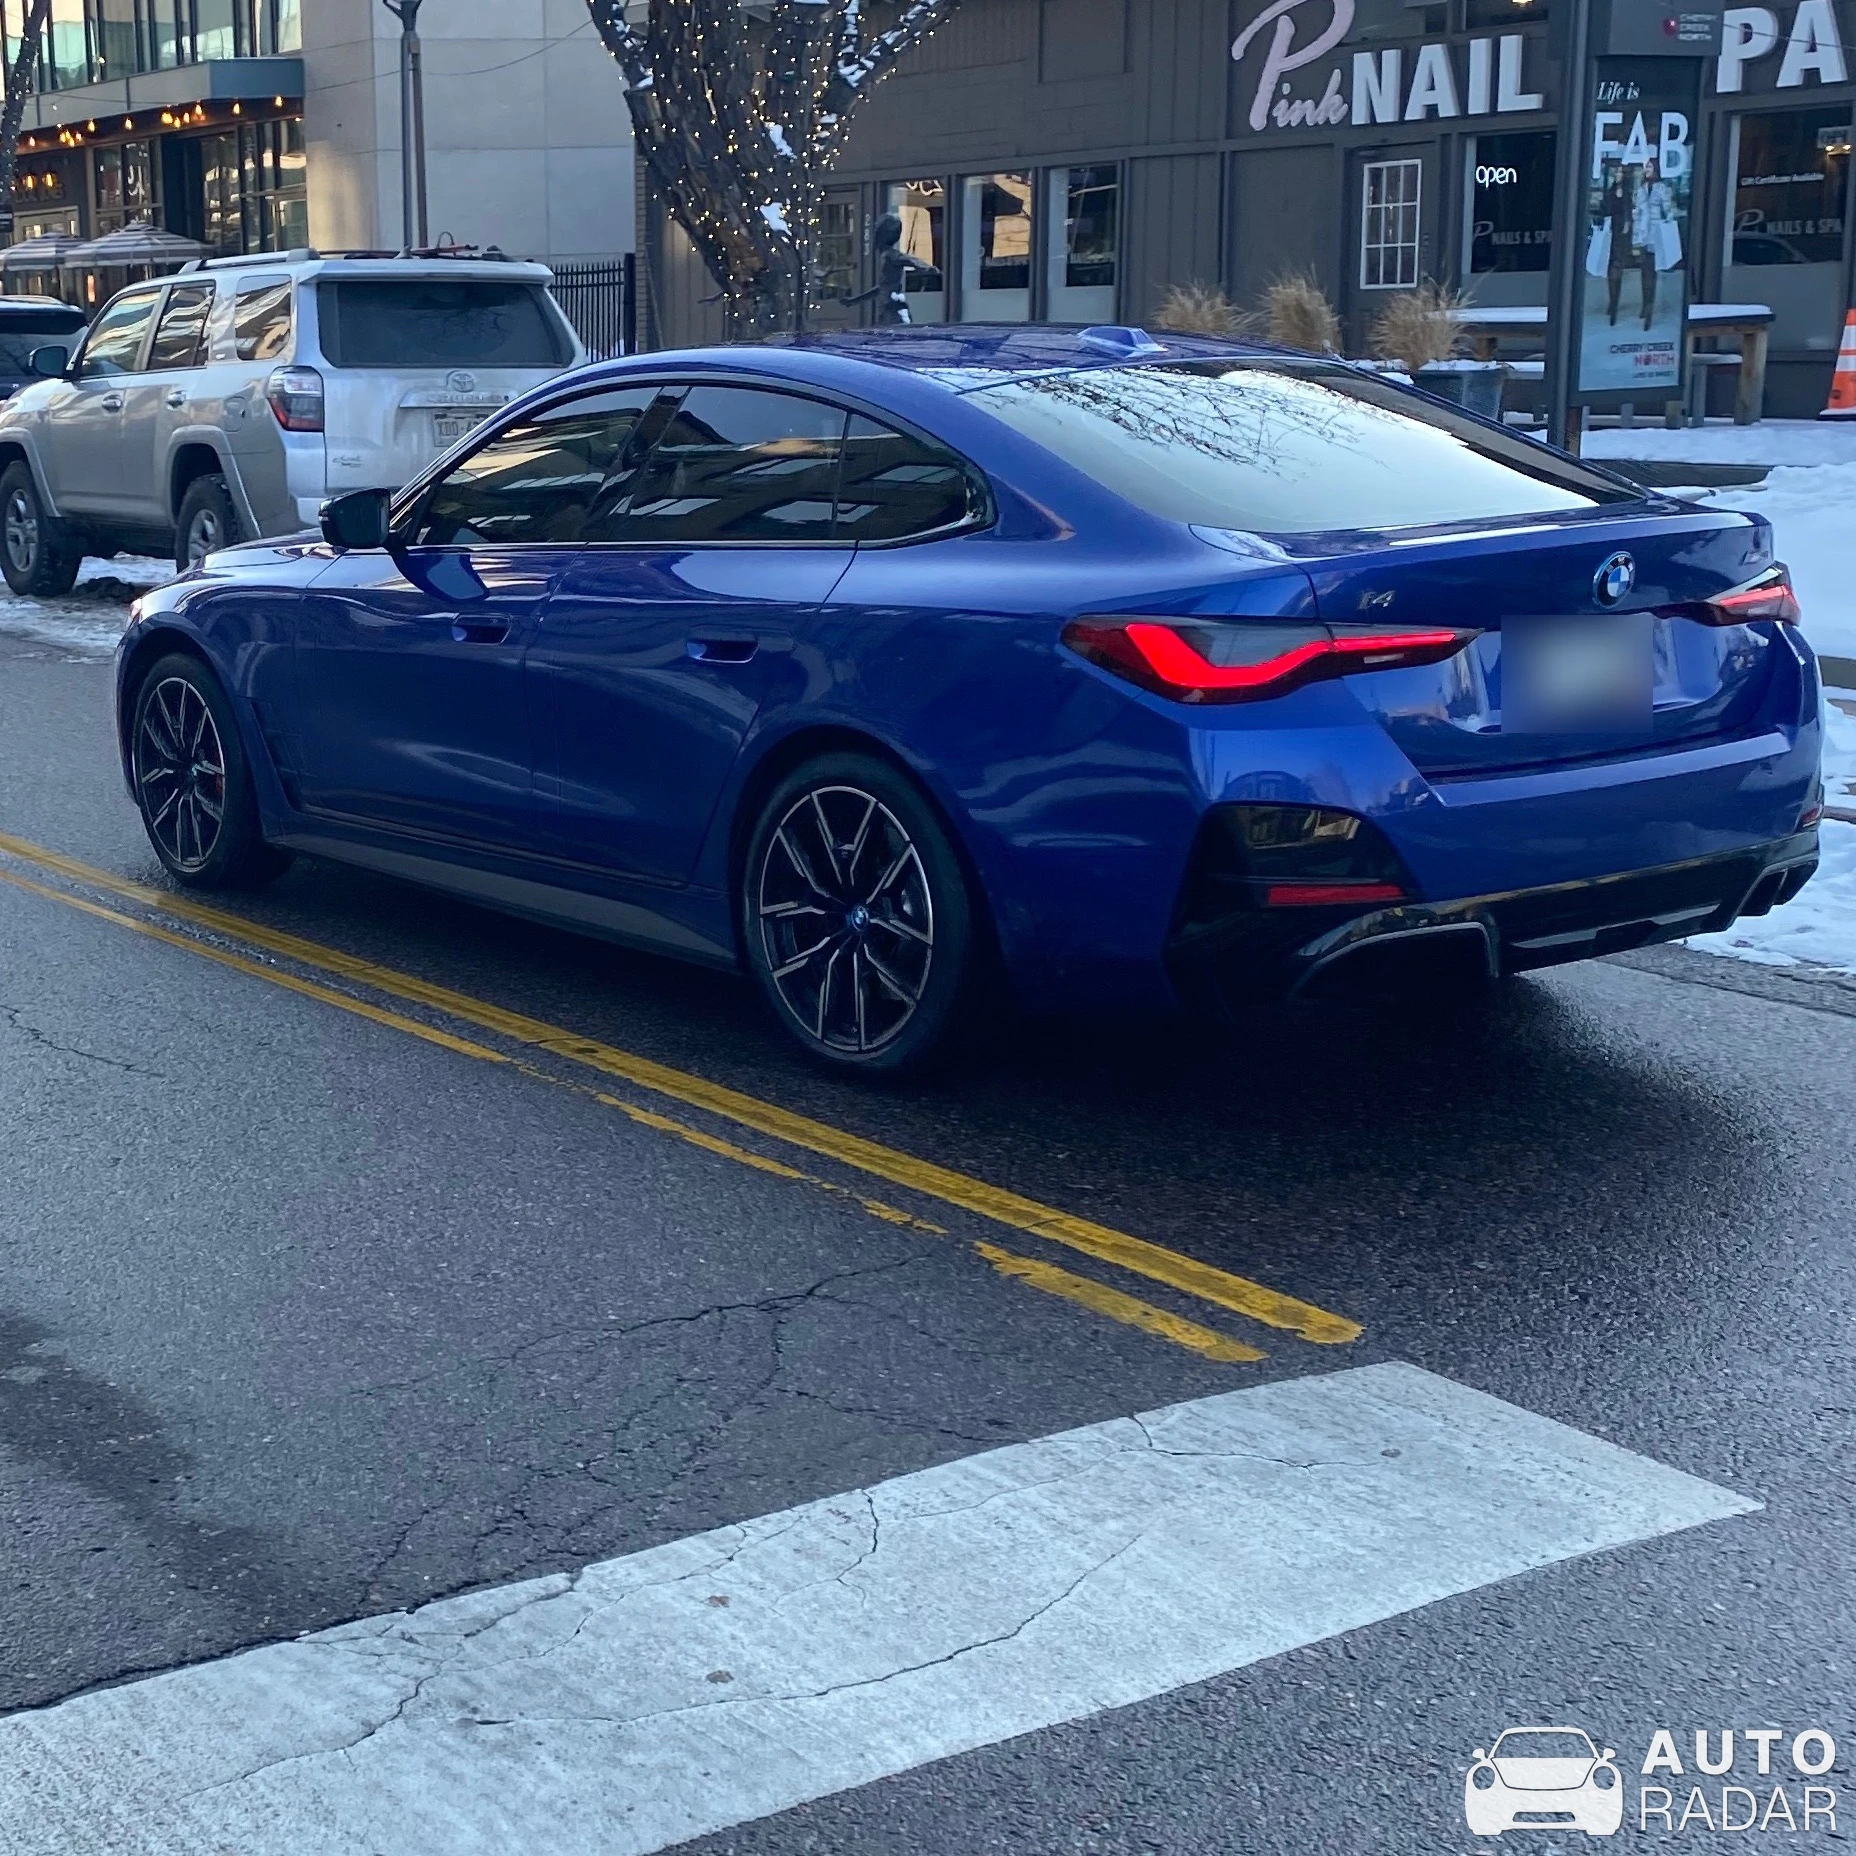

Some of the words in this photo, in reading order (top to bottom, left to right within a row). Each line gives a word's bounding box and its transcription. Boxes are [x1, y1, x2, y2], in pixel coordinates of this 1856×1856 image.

[1231, 0, 1349, 131] Pink
[1716, 0, 1849, 94] PA
[1597, 81, 1624, 105] Life
[1626, 81, 1640, 100] is
[1592, 110, 1689, 179] FAB
[1475, 165, 1518, 189] open
[1634, 353, 1675, 367] NORTH
